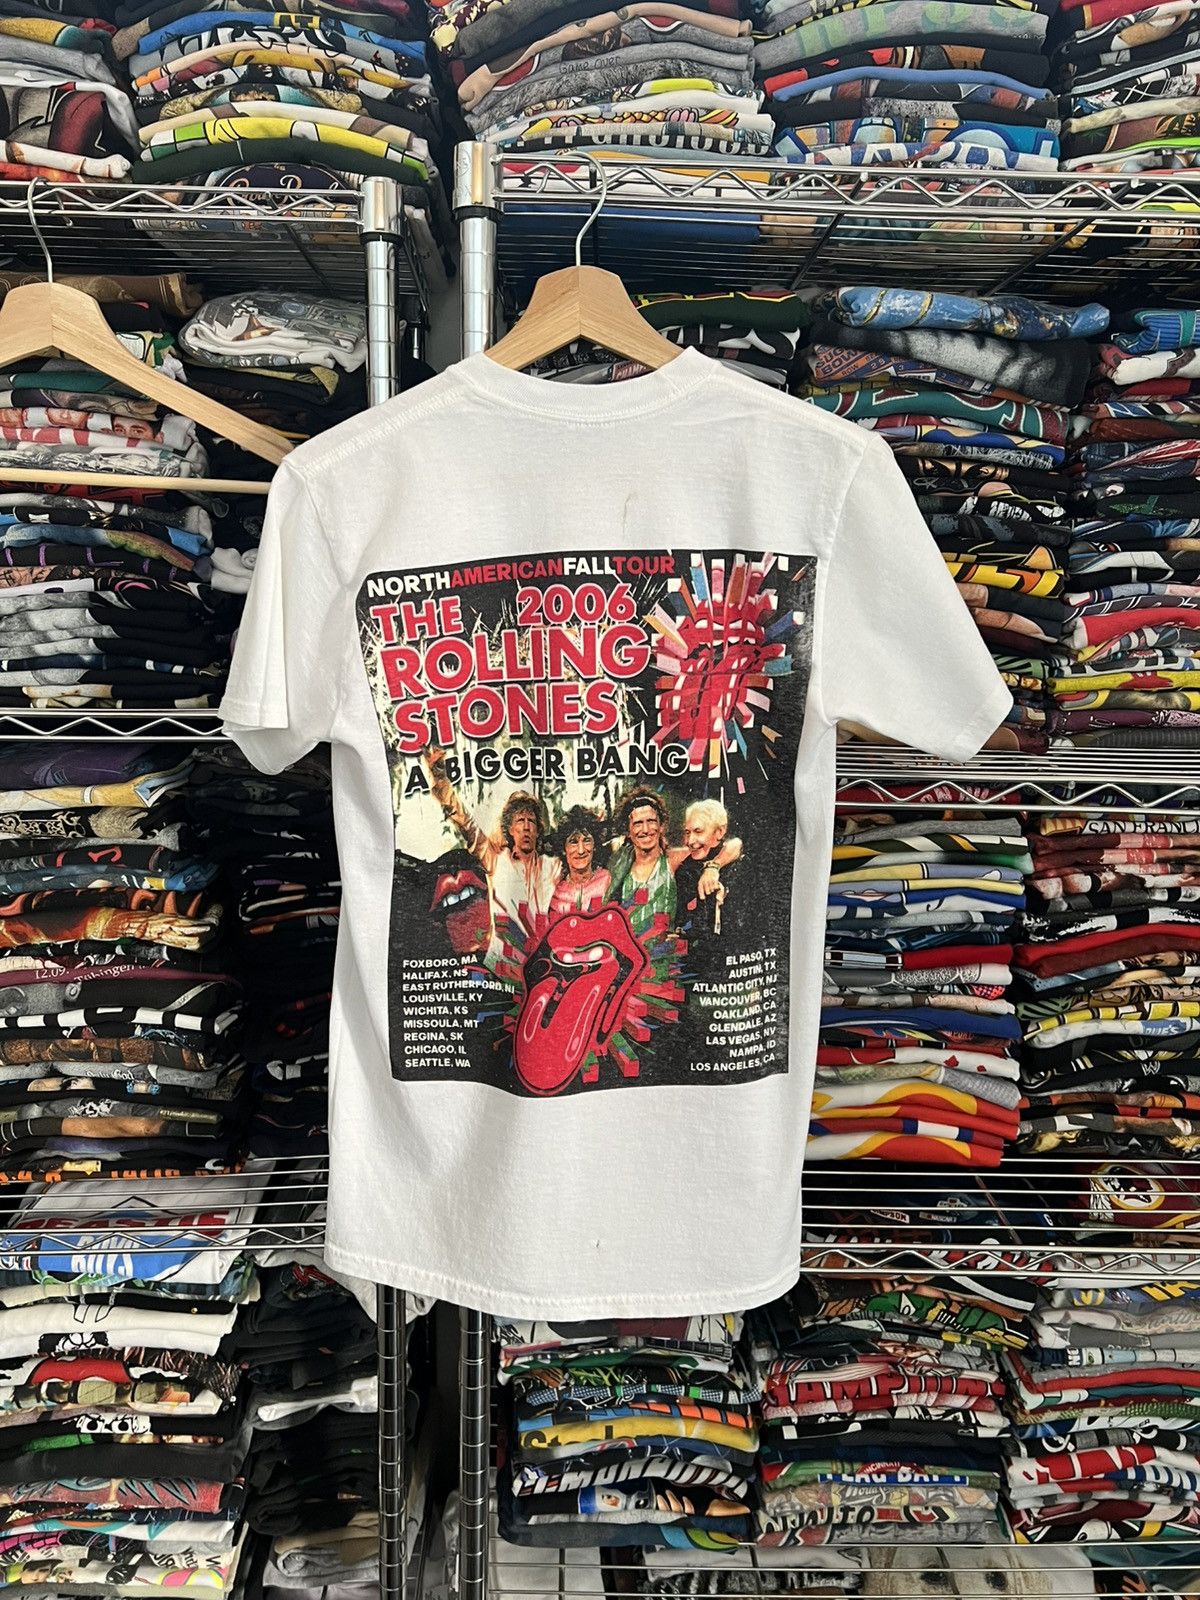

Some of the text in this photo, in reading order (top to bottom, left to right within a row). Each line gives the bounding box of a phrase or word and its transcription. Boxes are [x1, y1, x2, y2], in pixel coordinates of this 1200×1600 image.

[516, 582, 639, 627] 2006
[369, 595, 464, 644] THE
[380, 622, 651, 702] ROLLING
[393, 679, 619, 754] STONES
[404, 742, 691, 795] A BIGGER BANG
[402, 954, 478, 969] FOXBORO, MA
[726, 947, 777, 966] EL PASO, TX
[402, 968, 469, 981] HALIFAX, NS
[728, 960, 777, 980] AUSTIN, TX
[402, 983, 431, 992] EAST
[433, 980, 505, 993] RUTHERFORD,
[692, 974, 778, 994] ATLANTIC CITY, NJ
[402, 993, 483, 1004] LOUISVILLE, KY
[699, 987, 777, 1007] VANCOUVER, BC
[403, 1006, 469, 1016] WICHITA, KS
[713, 1001, 777, 1020] OAKLAND, CA
[403, 1019, 480, 1029] MISSOULA, MT
[709, 1013, 778, 1033] GLENDALE, AZ
[403, 1032, 464, 1042] REGINA, SK
[705, 1026, 777, 1046] LAS VEGAS, NV
[404, 1045, 467, 1055] CHICAGO, IL
[729, 1039, 776, 1058] NAMPA, ID
[405, 1058, 472, 1068] SEATTLE, WA
[690, 1052, 776, 1072] LOS ANGELES, CA
